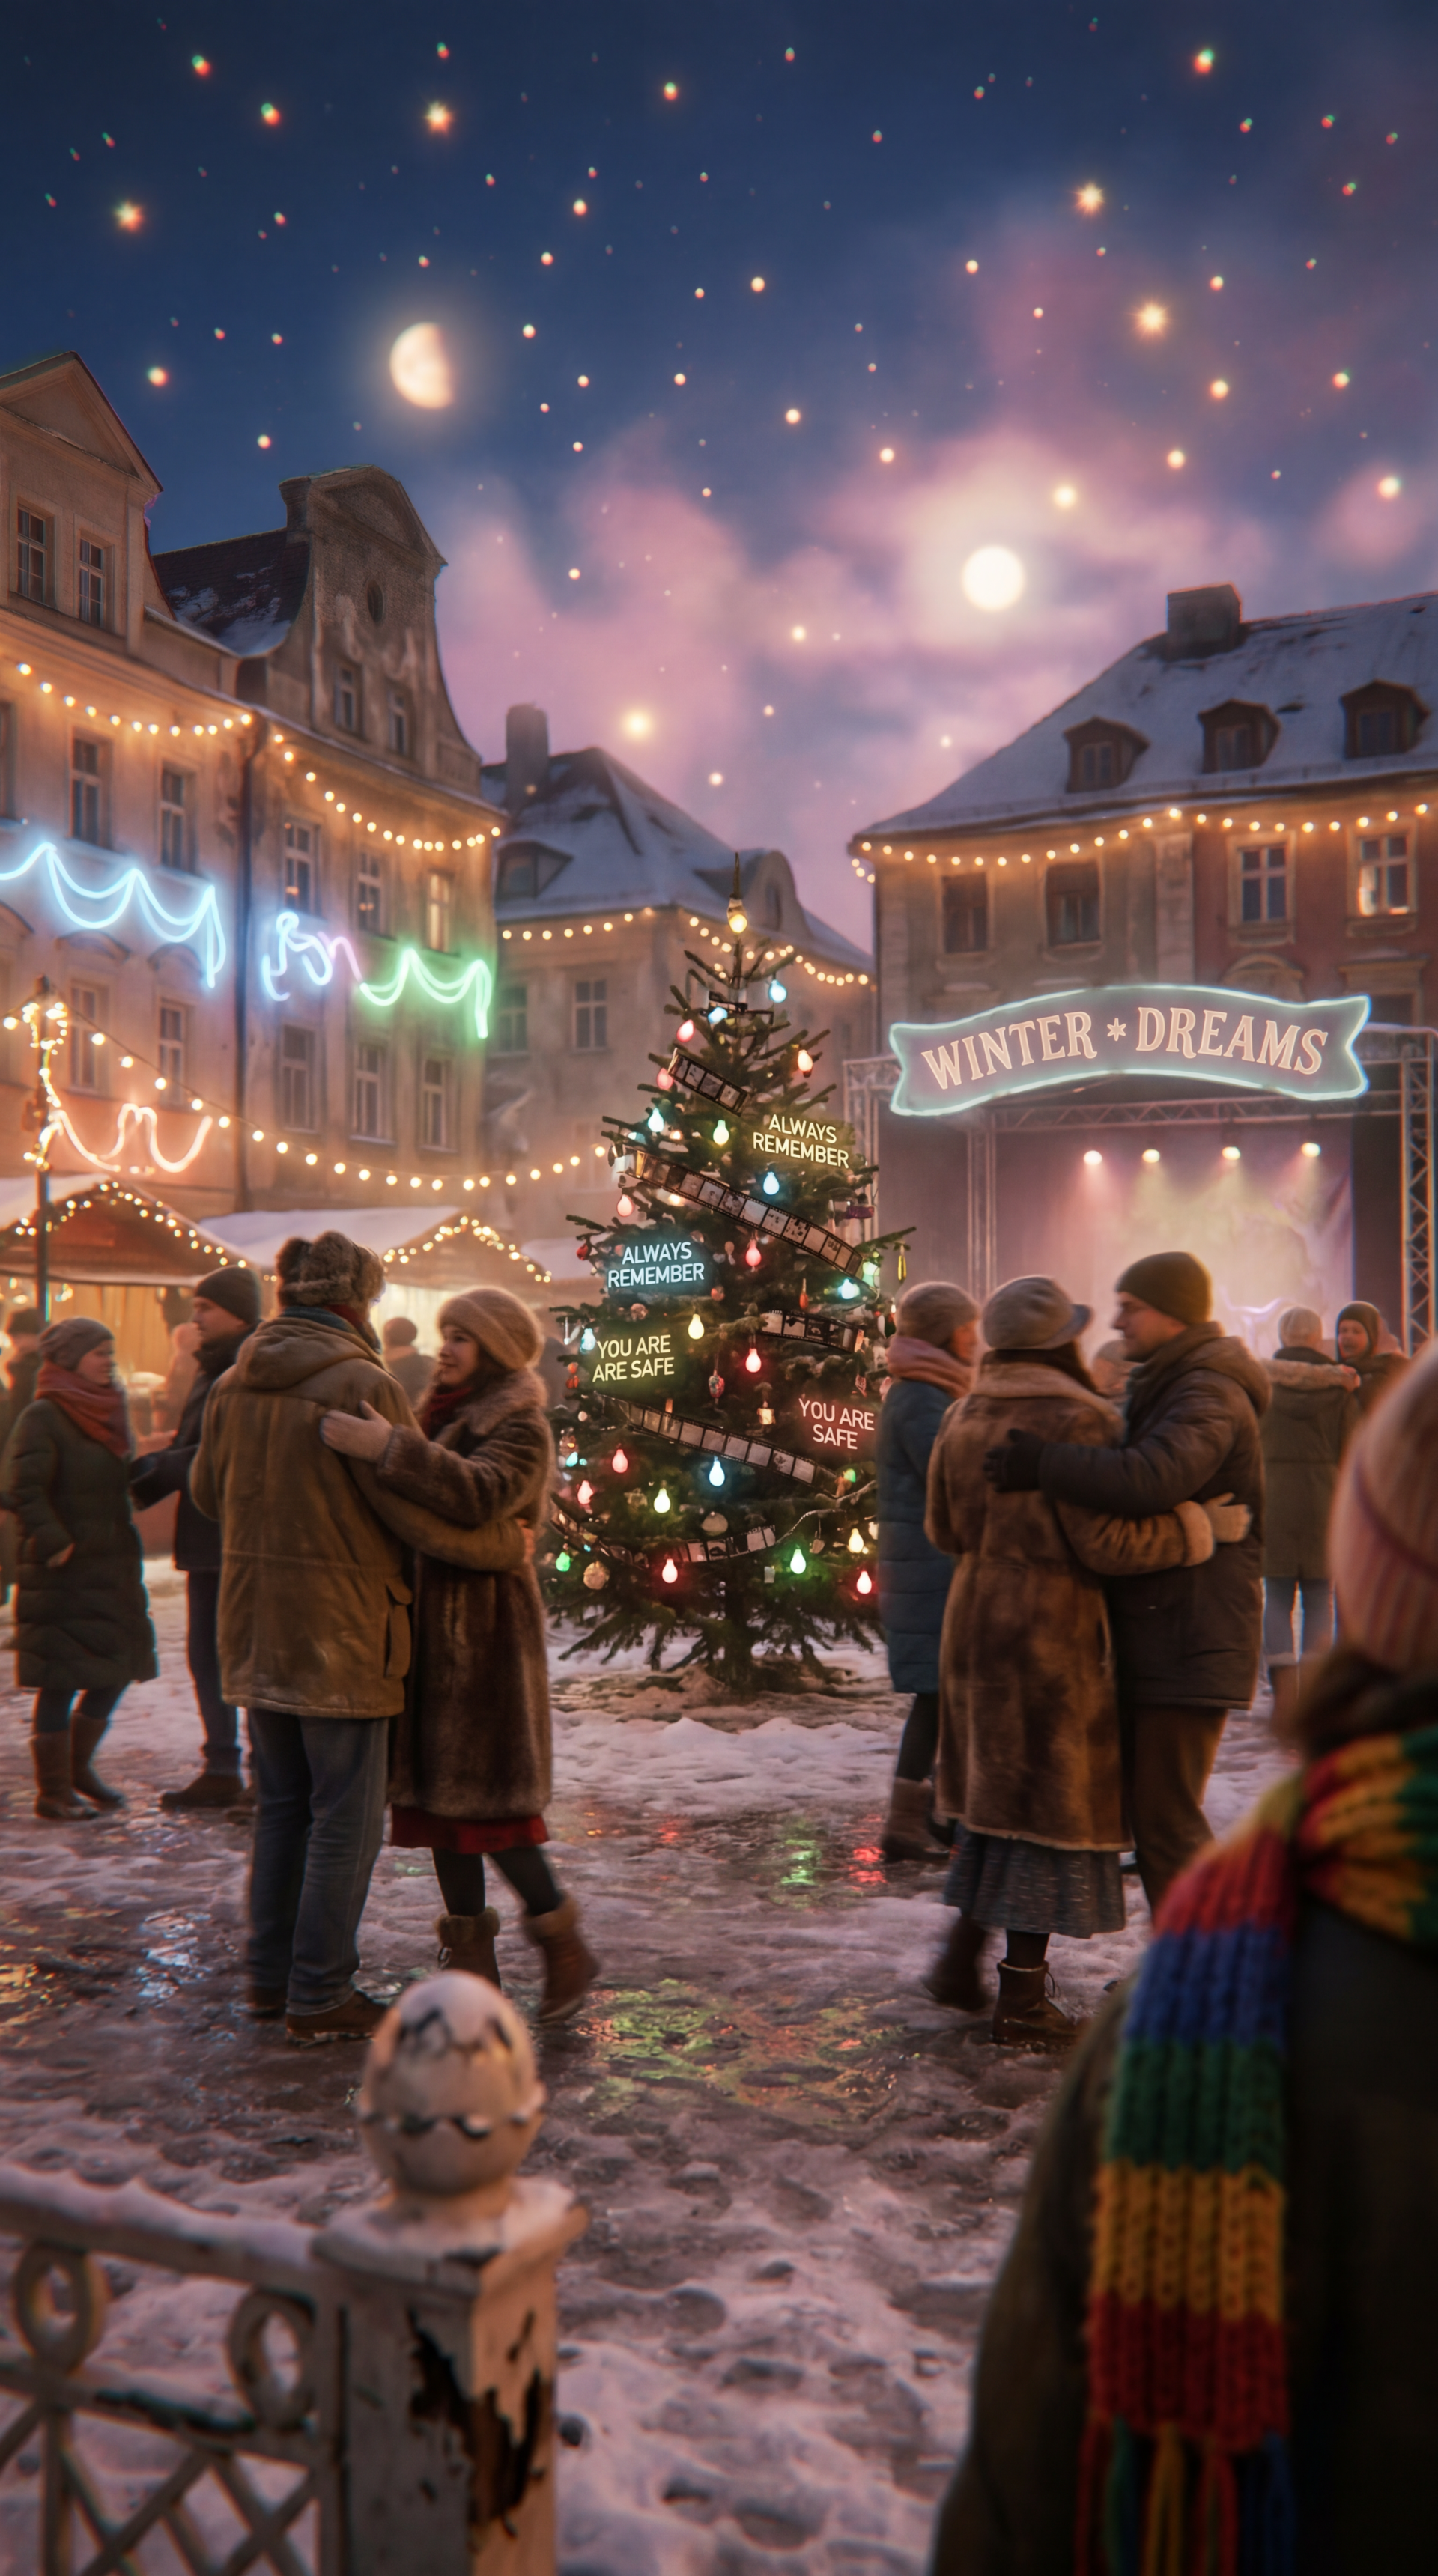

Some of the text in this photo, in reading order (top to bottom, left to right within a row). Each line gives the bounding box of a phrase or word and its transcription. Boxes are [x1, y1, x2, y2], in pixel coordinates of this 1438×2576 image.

[920, 1006, 1329, 1090] WINTER DREAMS
[768, 1114, 837, 1144] ALWAYS
[753, 1131, 849, 1169] REMEMBER
[622, 1241, 692, 1265] ALWAYS
[607, 1262, 705, 1288] REMEMBER
[597, 1334, 671, 1359] YOU ARE
[592, 1356, 675, 1382] ARE SAFE
[798, 1397, 875, 1431] YOU ARE
[813, 1424, 858, 1450] SAFE
